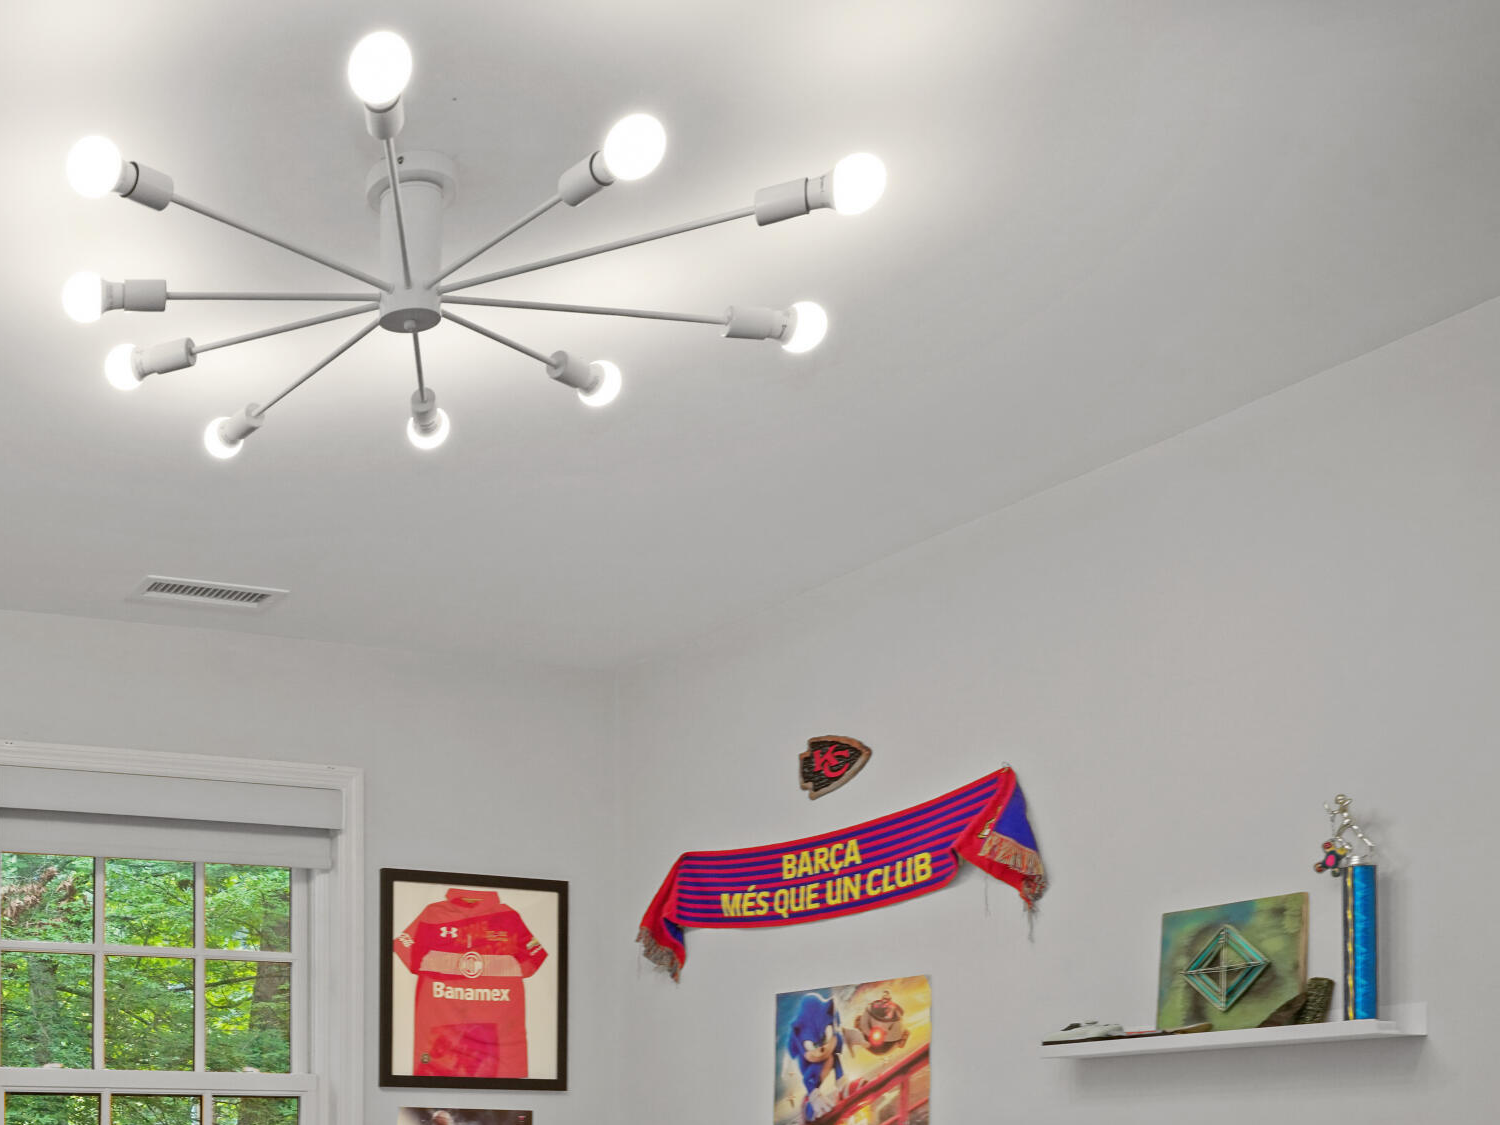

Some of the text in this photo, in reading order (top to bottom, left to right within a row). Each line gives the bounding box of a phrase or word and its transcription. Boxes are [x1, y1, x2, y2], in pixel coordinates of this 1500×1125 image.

[781, 839, 862, 881] BARÇA
[720, 851, 933, 919] MÉS QUE UN CLUB
[431, 981, 511, 1002] Banamex
